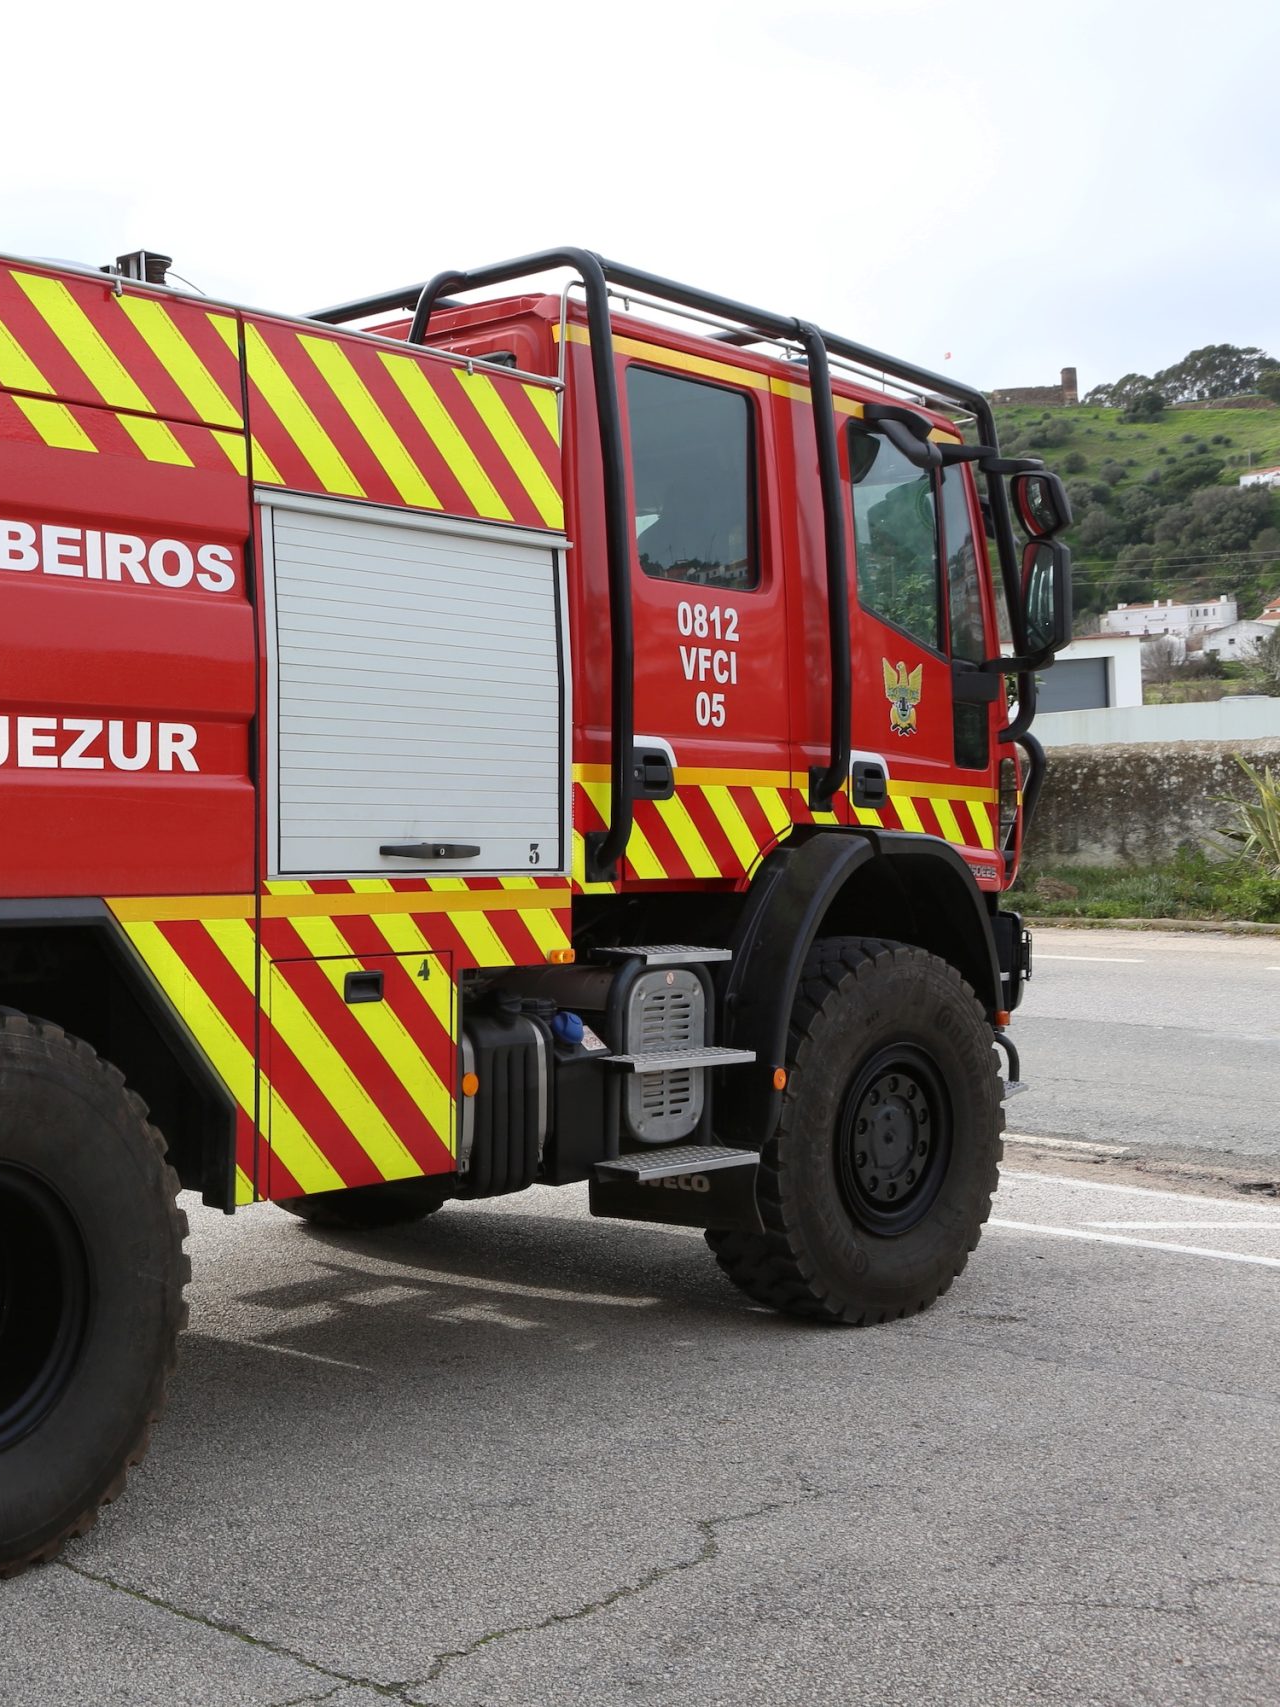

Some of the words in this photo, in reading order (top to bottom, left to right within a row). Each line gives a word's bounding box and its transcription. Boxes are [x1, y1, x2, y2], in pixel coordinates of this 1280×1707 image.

[677, 601, 740, 642] 0812
[679, 645, 737, 685] VFCI
[695, 691, 726, 727] 05
[417, 958, 430, 981] 4
